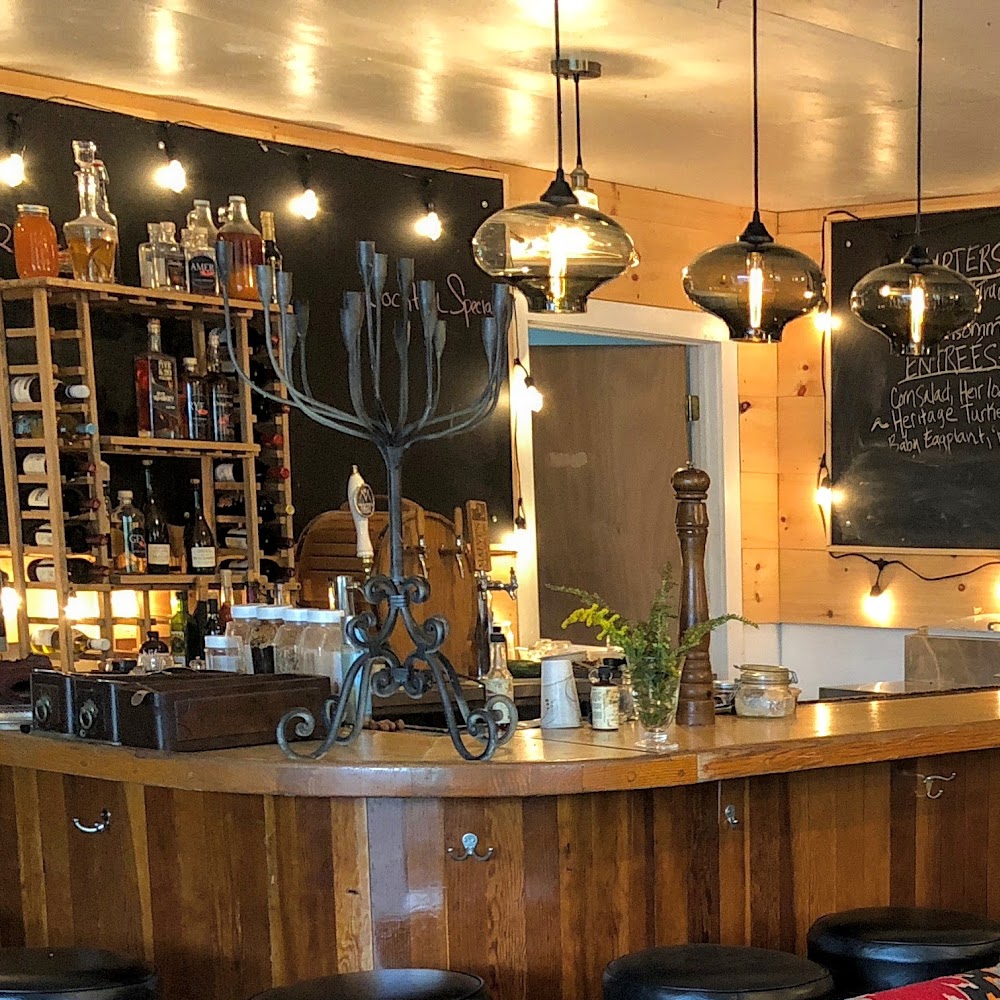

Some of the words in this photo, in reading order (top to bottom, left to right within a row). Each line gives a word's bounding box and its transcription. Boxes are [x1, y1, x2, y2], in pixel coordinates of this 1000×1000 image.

[447, 273, 494, 328] Specia
[891, 406, 958, 433] Heritage
[888, 431, 920, 454] Baby
[923, 426, 992, 452] Eggplant,
